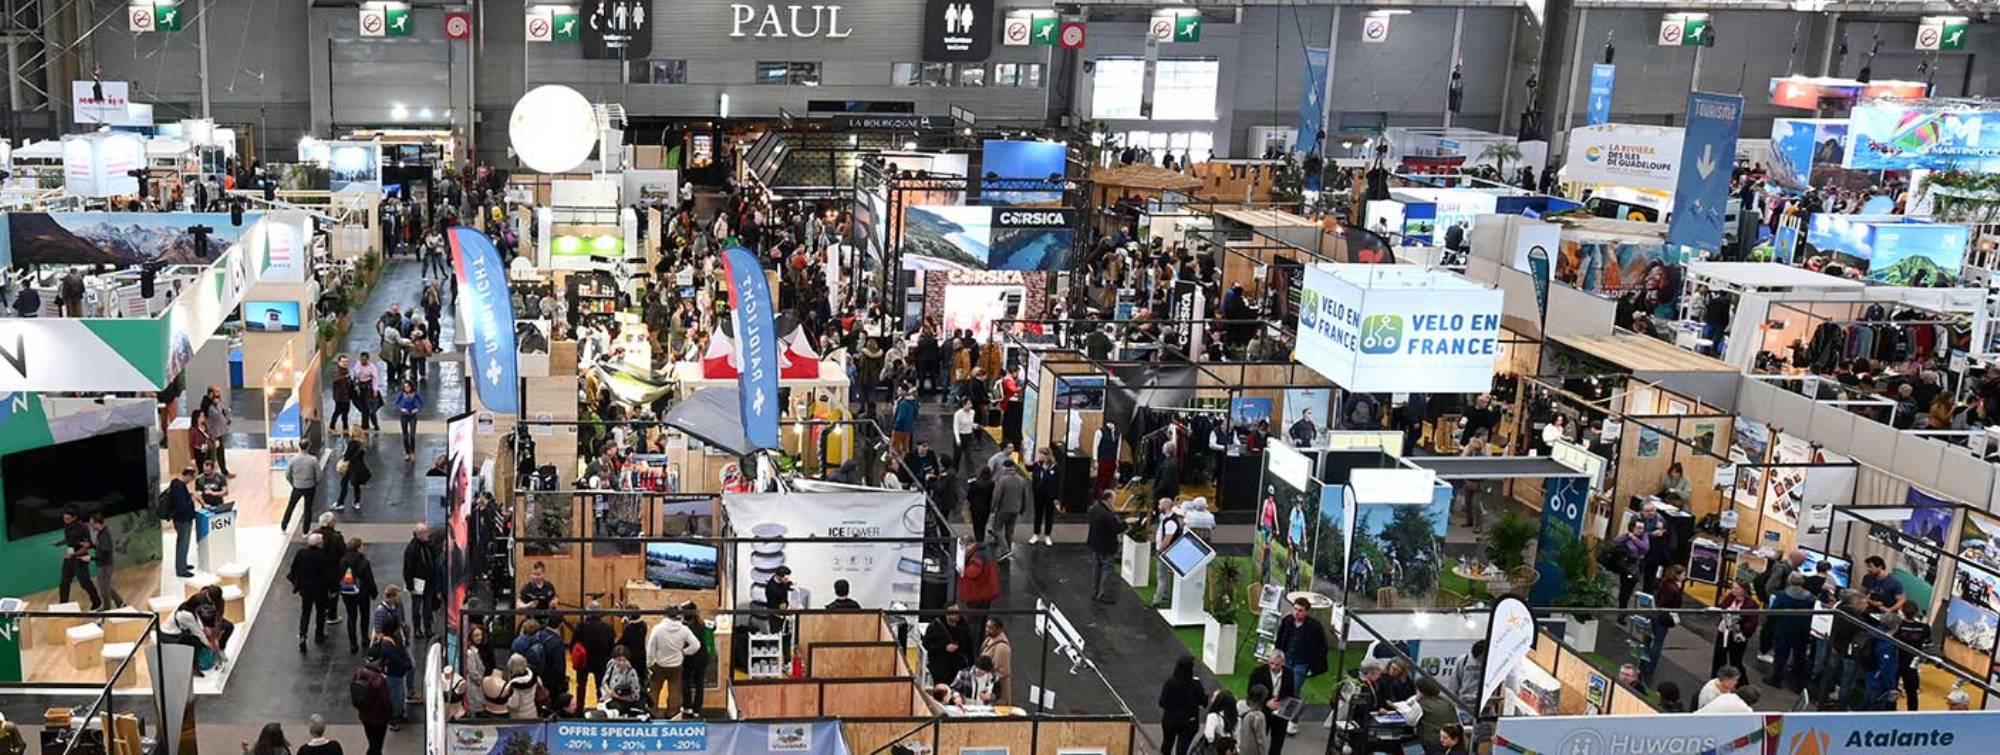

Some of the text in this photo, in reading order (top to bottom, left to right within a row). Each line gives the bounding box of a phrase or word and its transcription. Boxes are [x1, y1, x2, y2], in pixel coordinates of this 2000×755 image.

[728, 4, 853, 38] PAUL
[849, 119, 918, 128] LA BOURGOGNE
[1607, 151, 1624, 159] DES
[1618, 160, 1671, 171] GUADELOUPE
[1000, 212, 1065, 225] CORSICA
[948, 270, 1025, 284] CORSICA
[1323, 295, 1361, 328] VELO EN
[1412, 314, 1499, 332] VELO EN
[1317, 319, 1357, 352] FRANCE
[1407, 338, 1494, 355] FRANCE
[211, 517, 232, 530] IGN
[558, 725, 706, 737] OFFRE SPECIALE SALON
[564, 739, 701, 750] -20% -20% -20%
[1611, 734, 1716, 754] Huwans
[1845, 729, 1954, 748] Atalante
